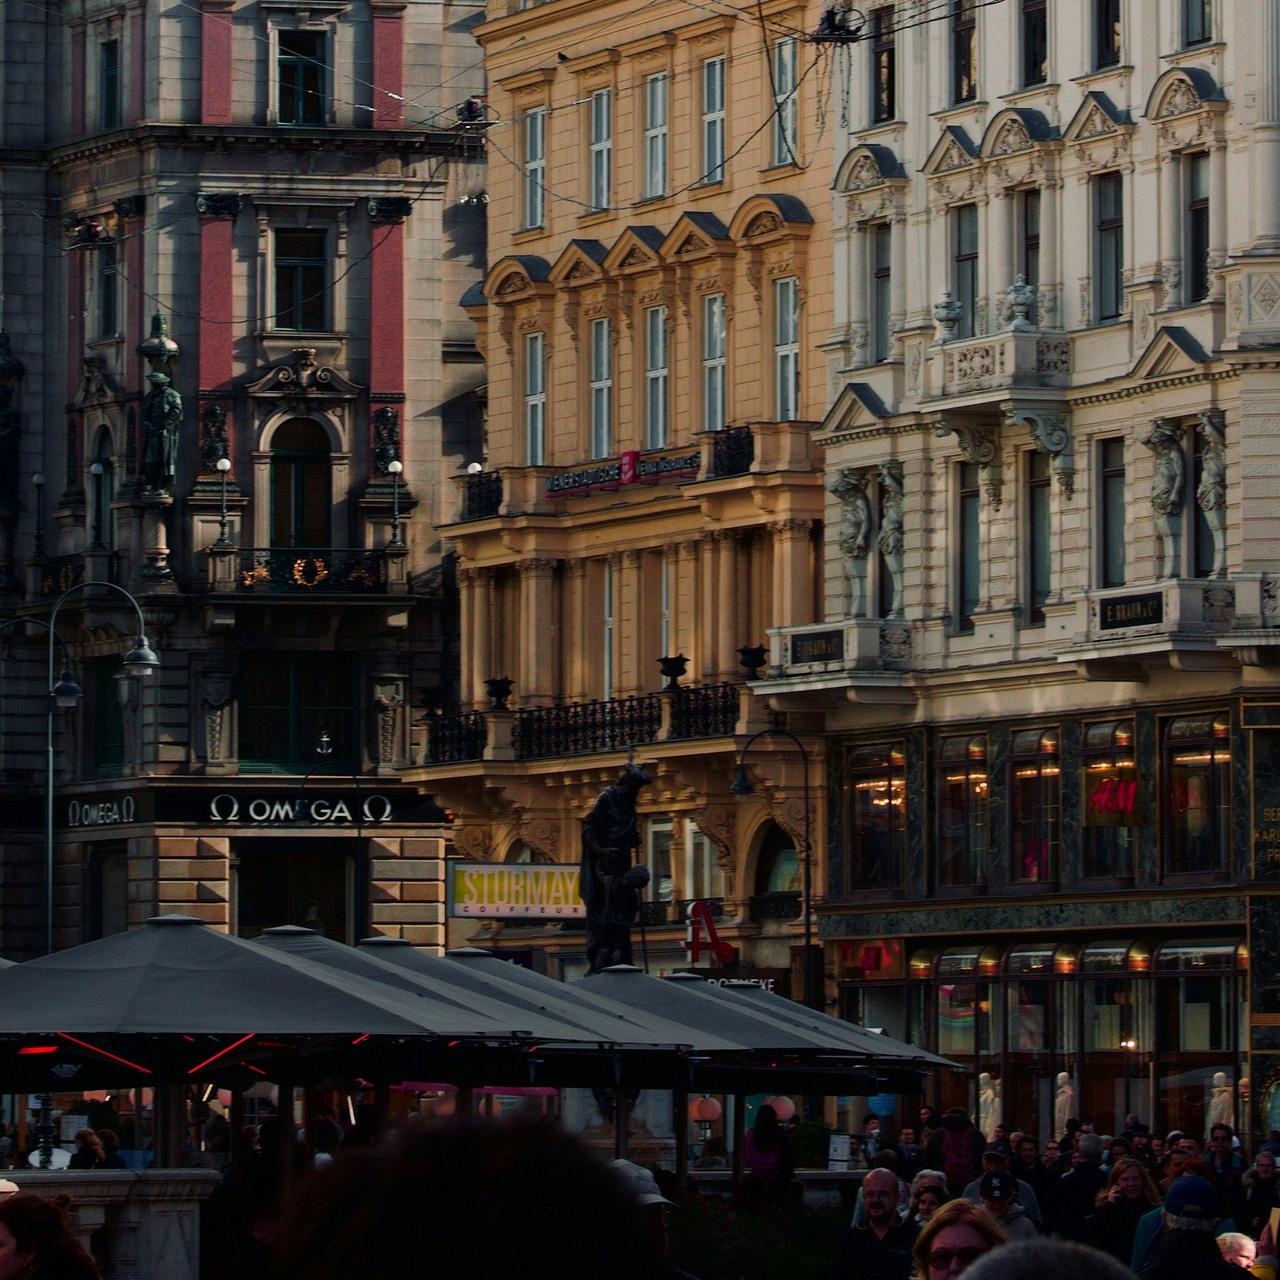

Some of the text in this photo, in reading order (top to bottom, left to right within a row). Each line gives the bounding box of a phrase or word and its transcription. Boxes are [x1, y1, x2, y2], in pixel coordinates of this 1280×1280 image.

[1089, 779, 1137, 815] H&M
[81, 800, 120, 825] OMEGA
[249, 799, 353, 821] OMGA
